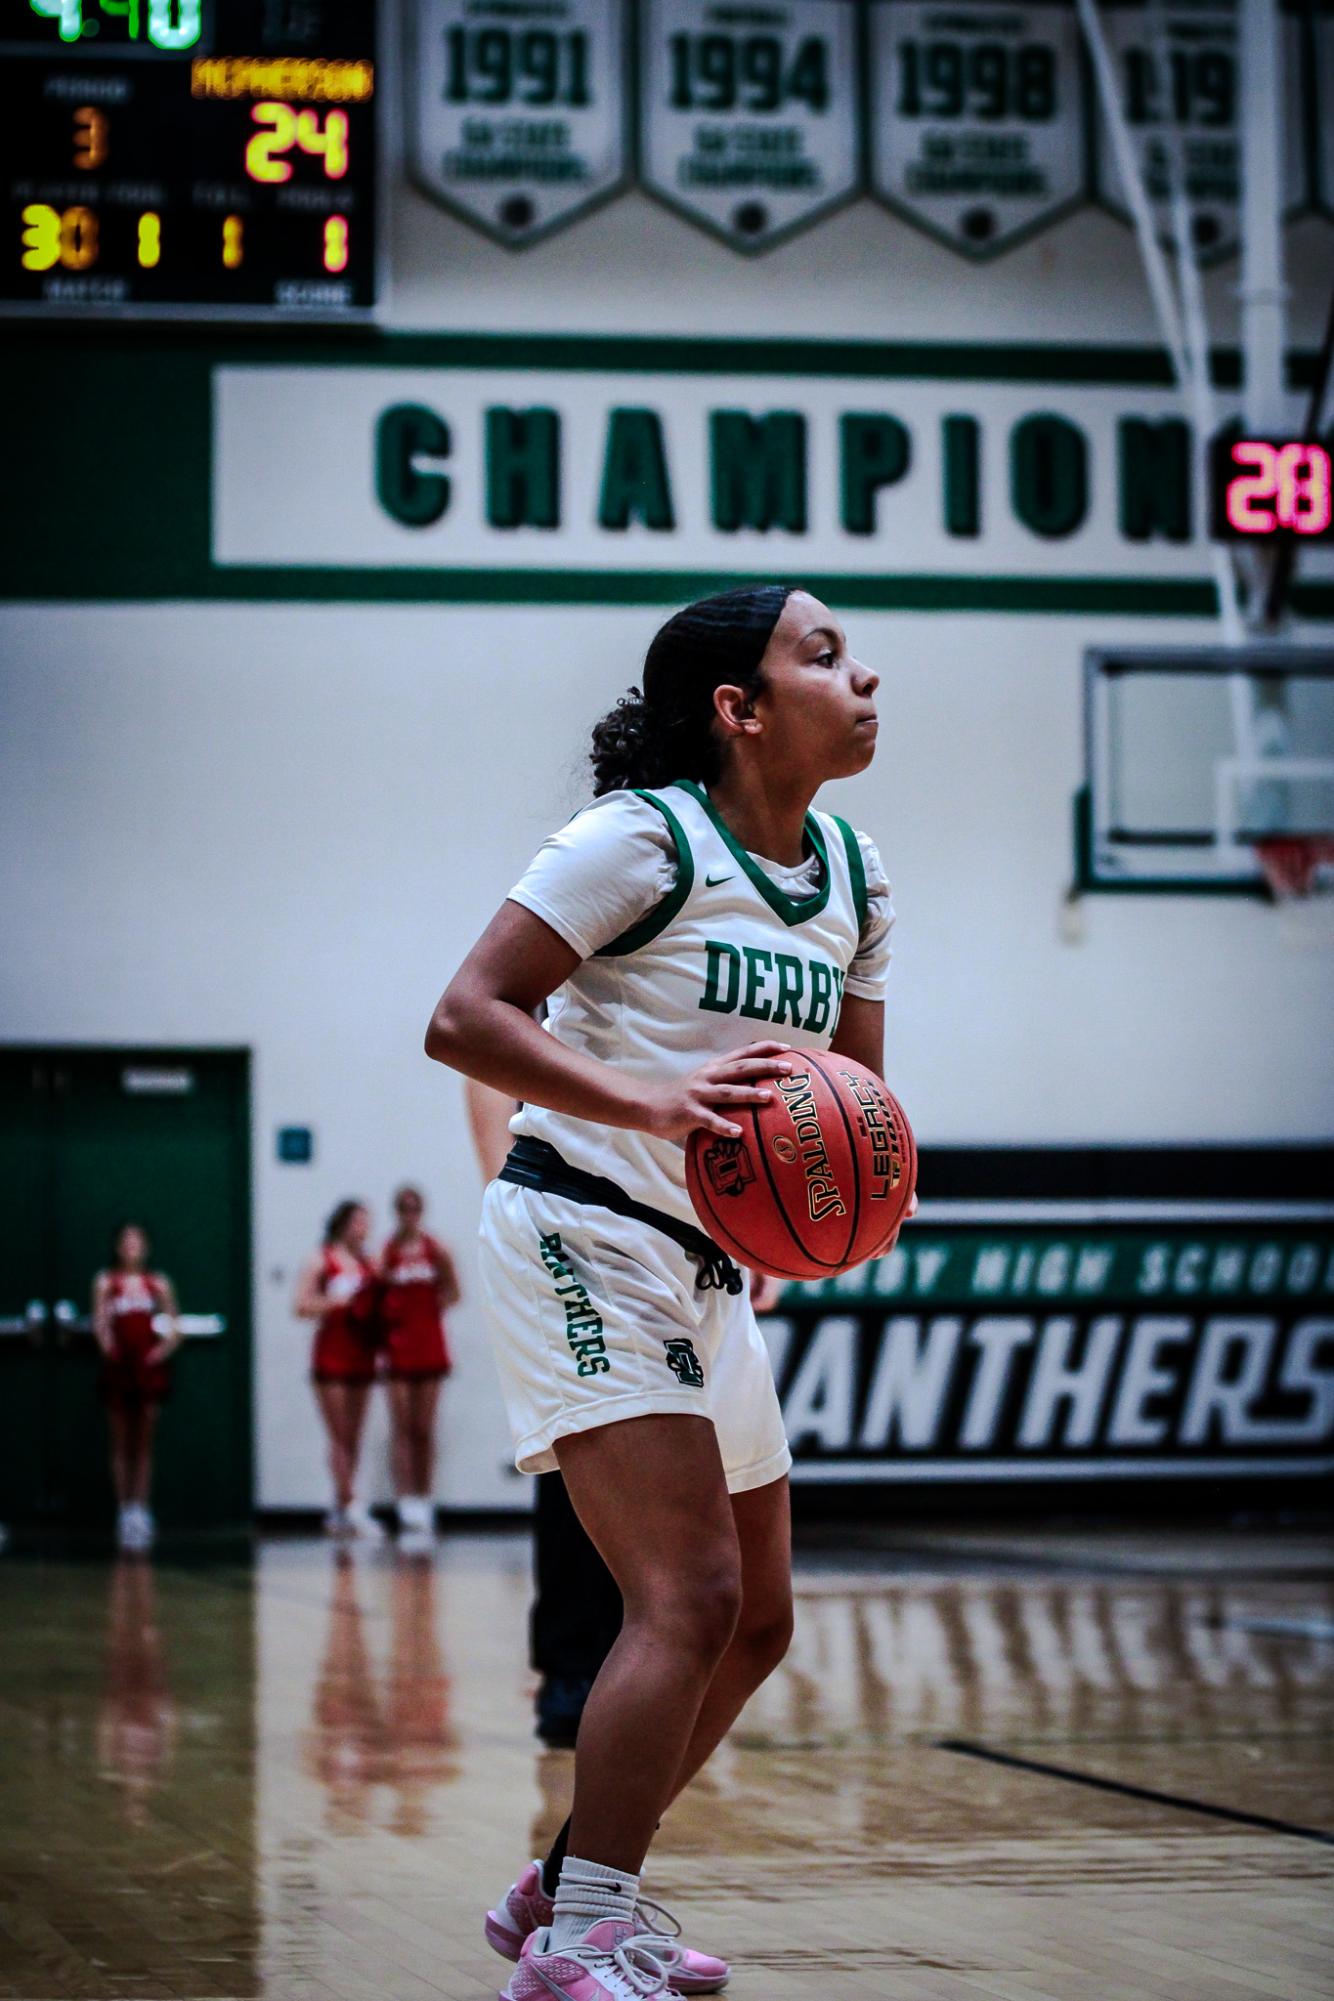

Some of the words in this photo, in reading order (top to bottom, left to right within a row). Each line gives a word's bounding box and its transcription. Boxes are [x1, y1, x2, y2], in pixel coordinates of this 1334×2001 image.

[447, 25, 589, 107] 1991
[671, 32, 829, 112] 1994
[899, 41, 1056, 120] 1998
[73, 106, 107, 170] 3
[245, 100, 349, 183] 24
[22, 204, 98, 271] 30
[137, 211, 161, 268] 1
[222, 214, 244, 269] 1
[323, 214, 348, 272] 1
[374, 402, 1238, 544] CHAMPION
[774, 1072, 846, 1222] SPALDING
[836, 1071, 890, 1200] LEGACY
[970, 1242, 1113, 1297] HIGH
